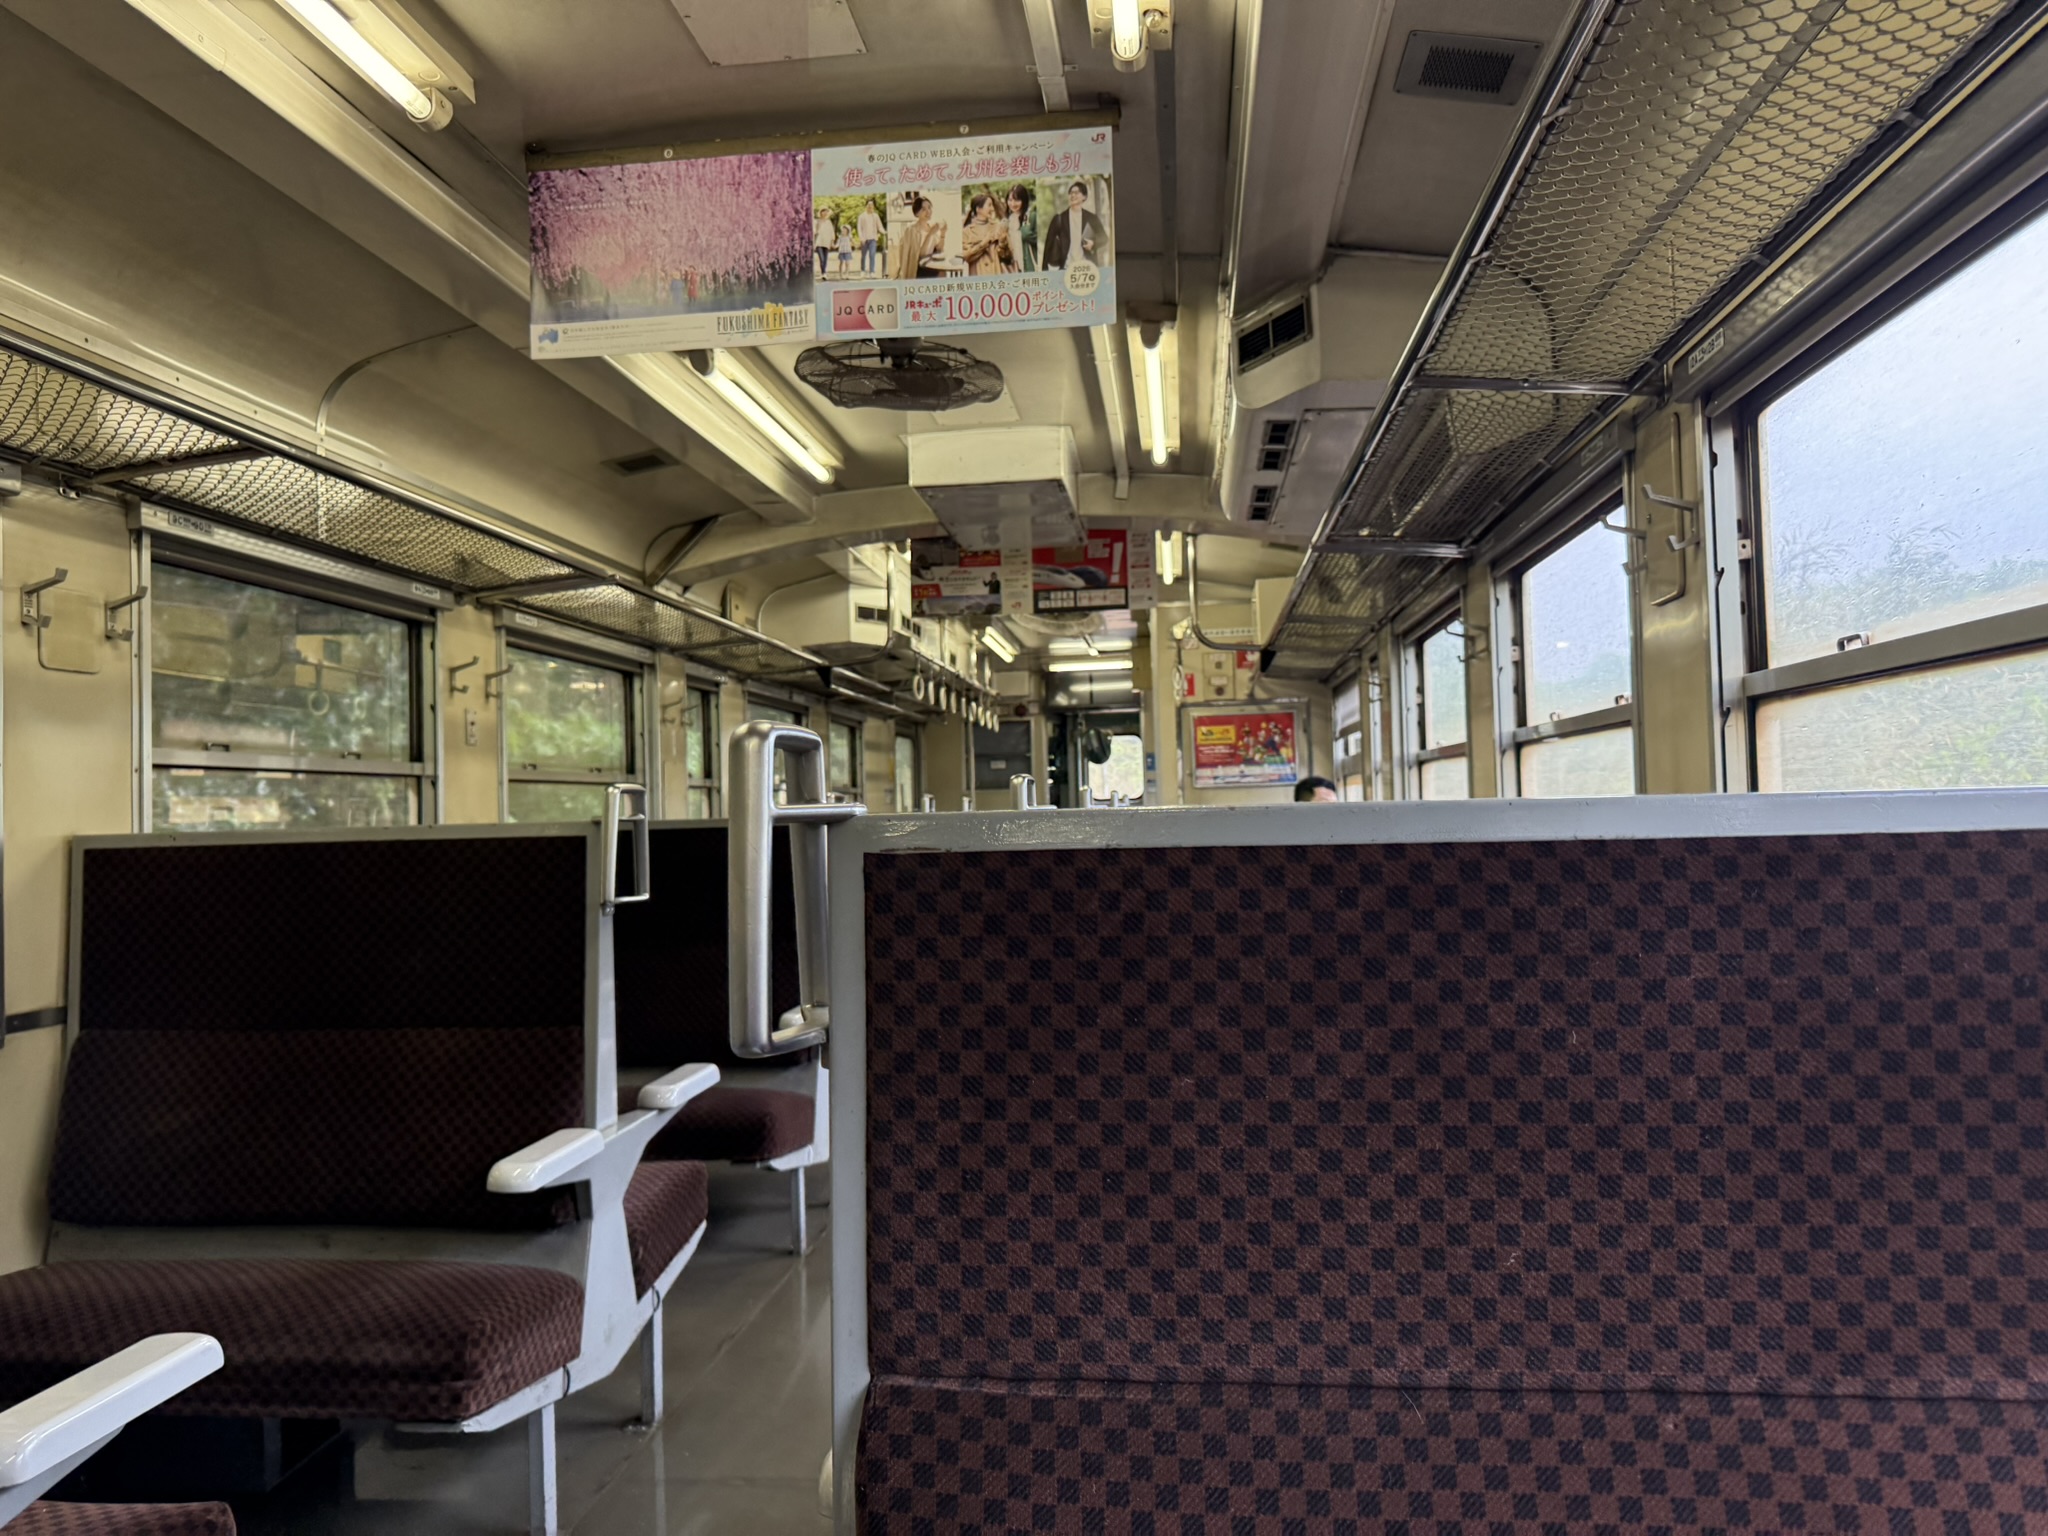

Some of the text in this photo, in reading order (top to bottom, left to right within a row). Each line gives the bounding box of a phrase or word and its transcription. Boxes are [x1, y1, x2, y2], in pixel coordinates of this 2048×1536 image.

[1091, 133, 1106, 142] JR
[868, 152, 896, 163] 春のJQ
[899, 151, 927, 161] CARD
[904, 286, 915, 296] JQ
[1032, 290, 1065, 301] ポイント
[836, 304, 895, 316] JQ CARD
[945, 291, 1031, 321] 10,000
[717, 309, 809, 332] FUKUSHIMA FANTASY
